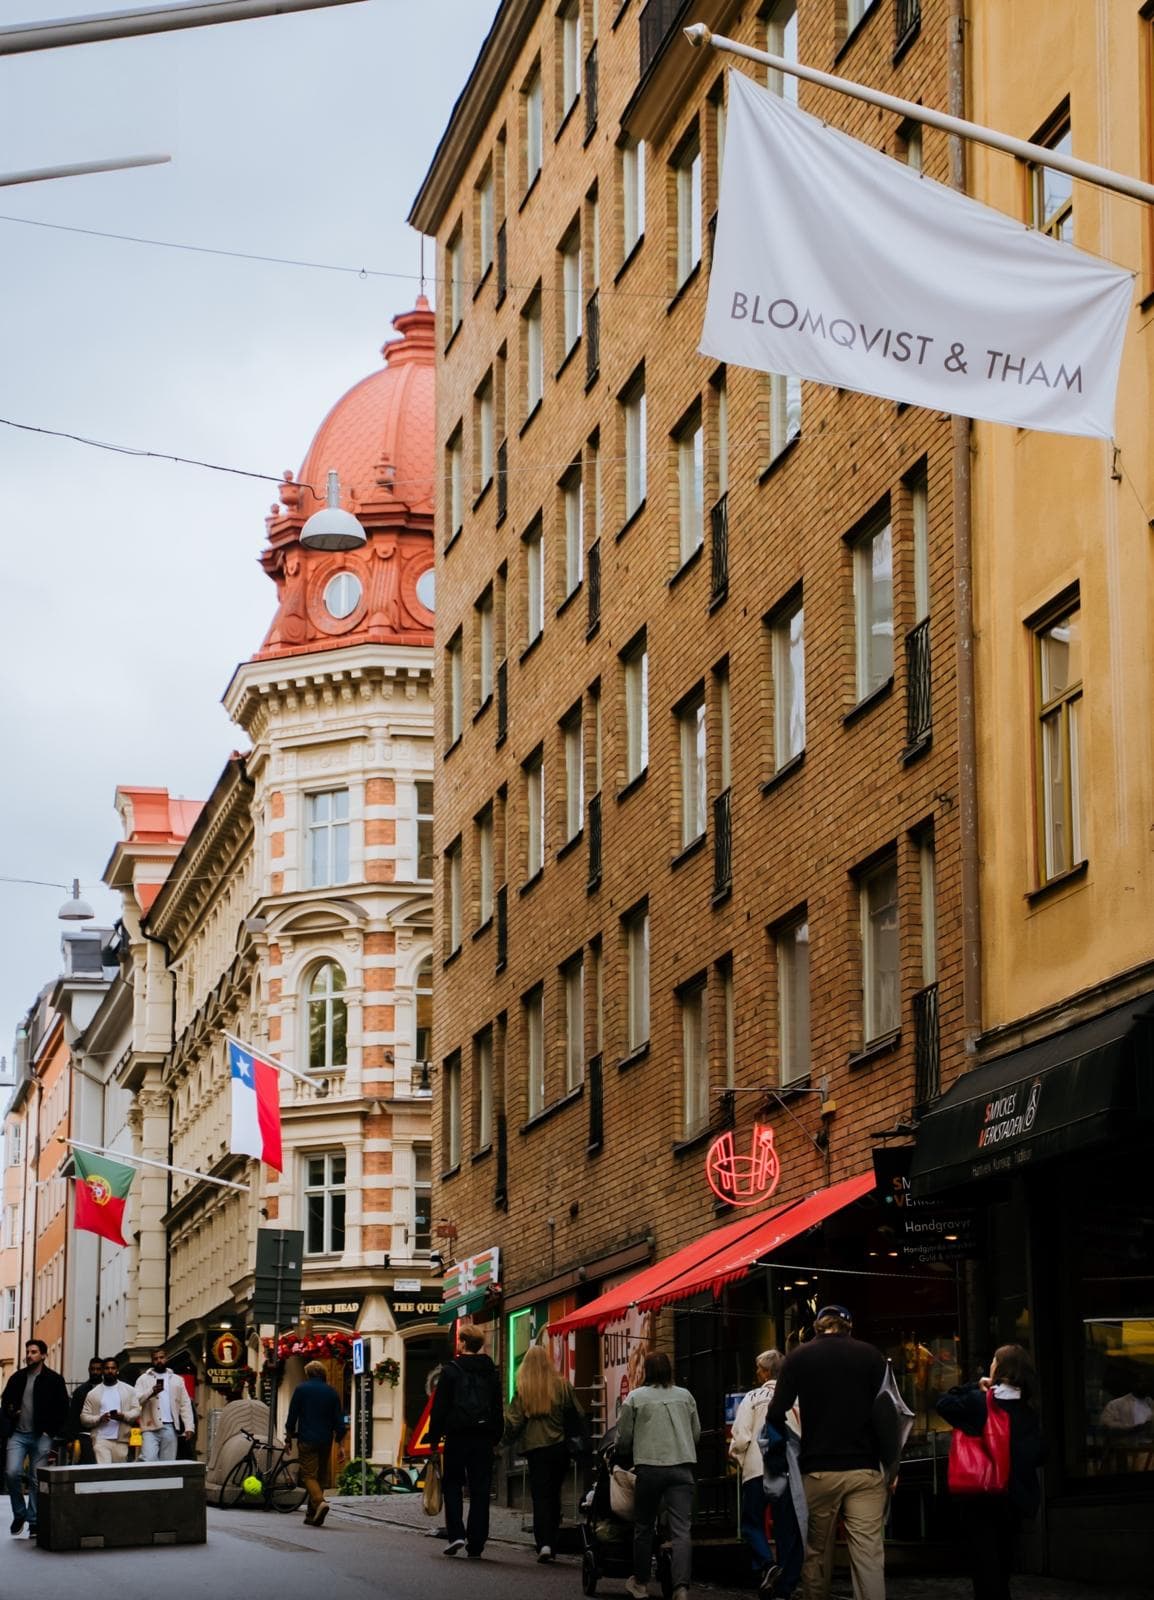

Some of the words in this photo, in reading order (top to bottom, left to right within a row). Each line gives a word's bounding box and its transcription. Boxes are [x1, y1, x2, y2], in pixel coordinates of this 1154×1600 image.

[730, 291, 934, 364] BLOMQVIST
[943, 342, 968, 374] &
[986, 349, 1083, 394] THAM
[984, 1092, 1017, 1123] SMYCKES
[305, 1304, 333, 1315] UEENS
[334, 1303, 359, 1313] HEAD
[393, 1302, 415, 1312] THE
[211, 1376, 233, 1384] HEA
